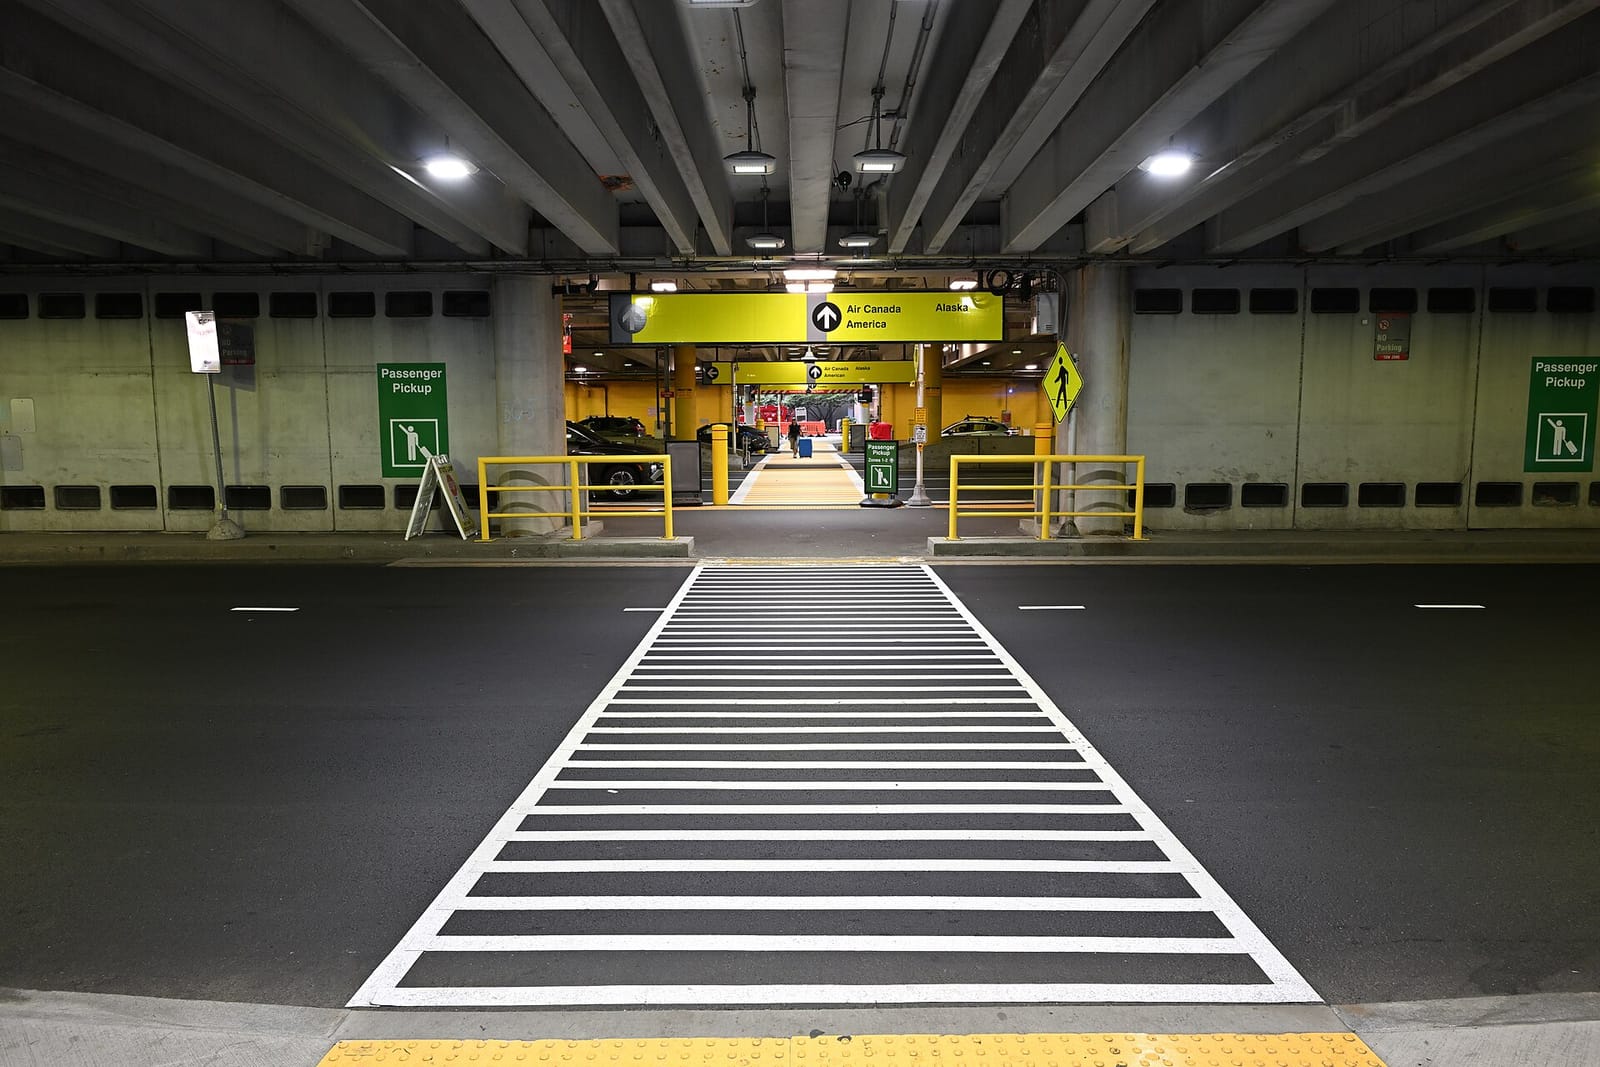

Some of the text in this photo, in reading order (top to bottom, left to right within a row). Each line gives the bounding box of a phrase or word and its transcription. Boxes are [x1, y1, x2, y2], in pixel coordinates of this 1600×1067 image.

[847, 304, 901, 314] Air Canada
[935, 303, 969, 313] Alaska
[846, 319, 887, 329] America
[381, 368, 442, 381] Passenger
[1536, 362, 1598, 375] Passenger
[1545, 377, 1586, 389] Pickup
[392, 383, 432, 396] Pickup
